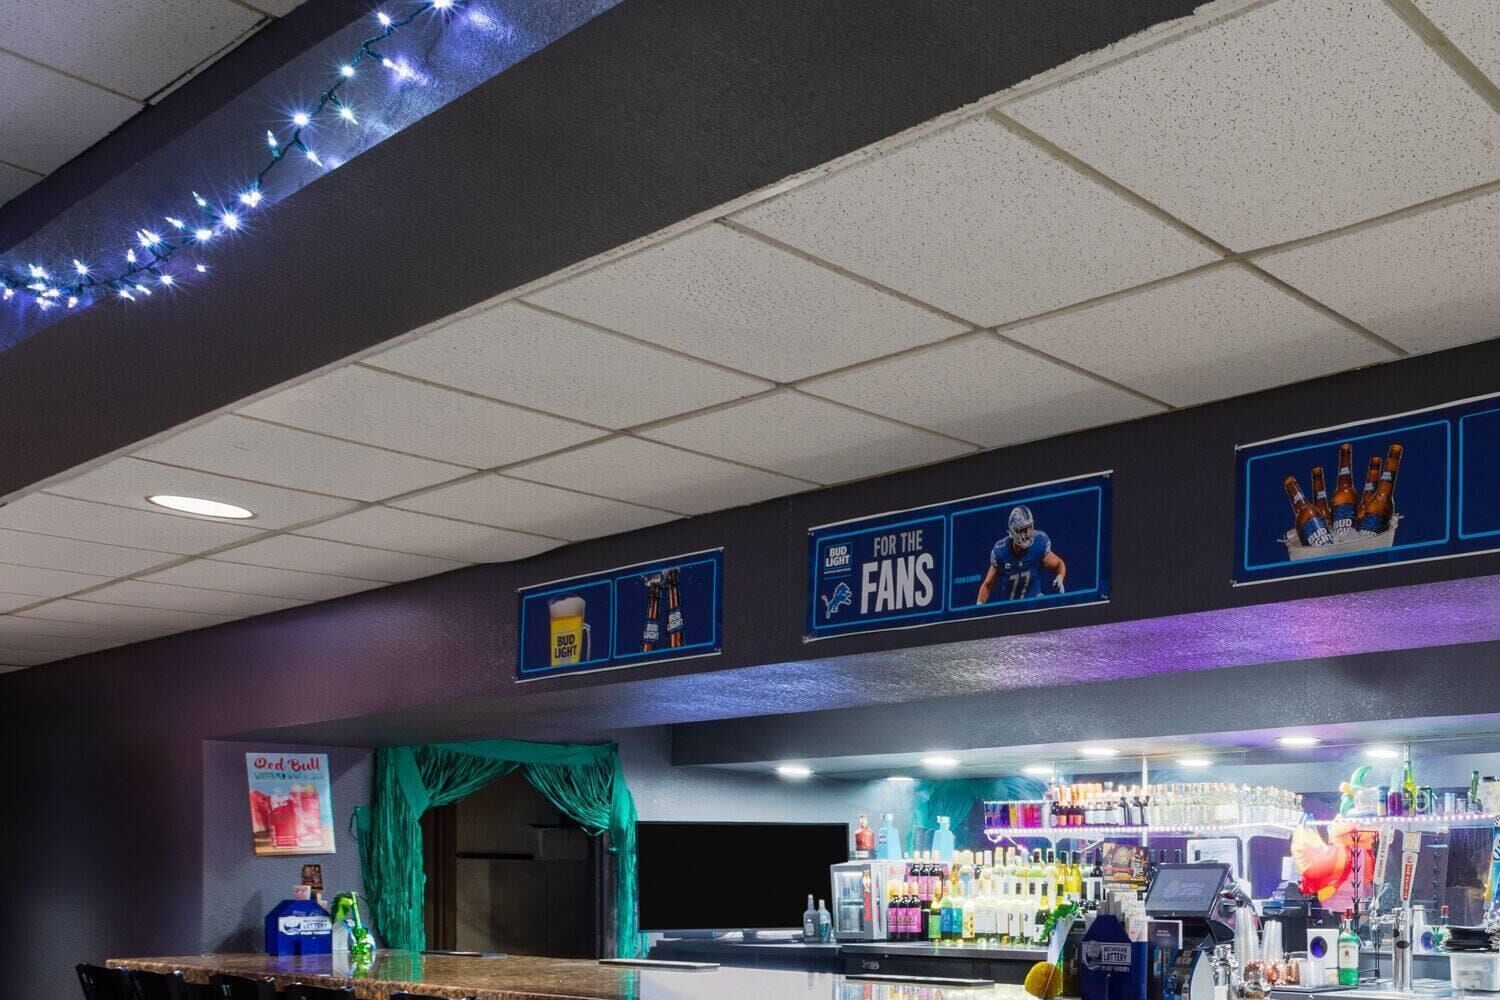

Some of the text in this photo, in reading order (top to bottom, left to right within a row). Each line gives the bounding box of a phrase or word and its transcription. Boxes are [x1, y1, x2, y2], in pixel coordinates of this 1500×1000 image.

[1333, 518, 1353, 529] BUD
[1307, 527, 1328, 545] BUD
[873, 529, 923, 558] FOR THE
[829, 545, 848, 558] BUD
[825, 554, 851, 567] LIGHT
[860, 552, 935, 615] FANS
[1008, 570, 1031, 600] 77
[668, 611, 682, 623] BUD
[646, 623, 659, 632] BUD
[557, 633, 576, 647] BUD
[643, 630, 660, 641] LIGHT
[554, 645, 578, 659] LIGHT
[287, 757, 320, 772] Bull
[1102, 952, 1128, 962] LOTTERY
